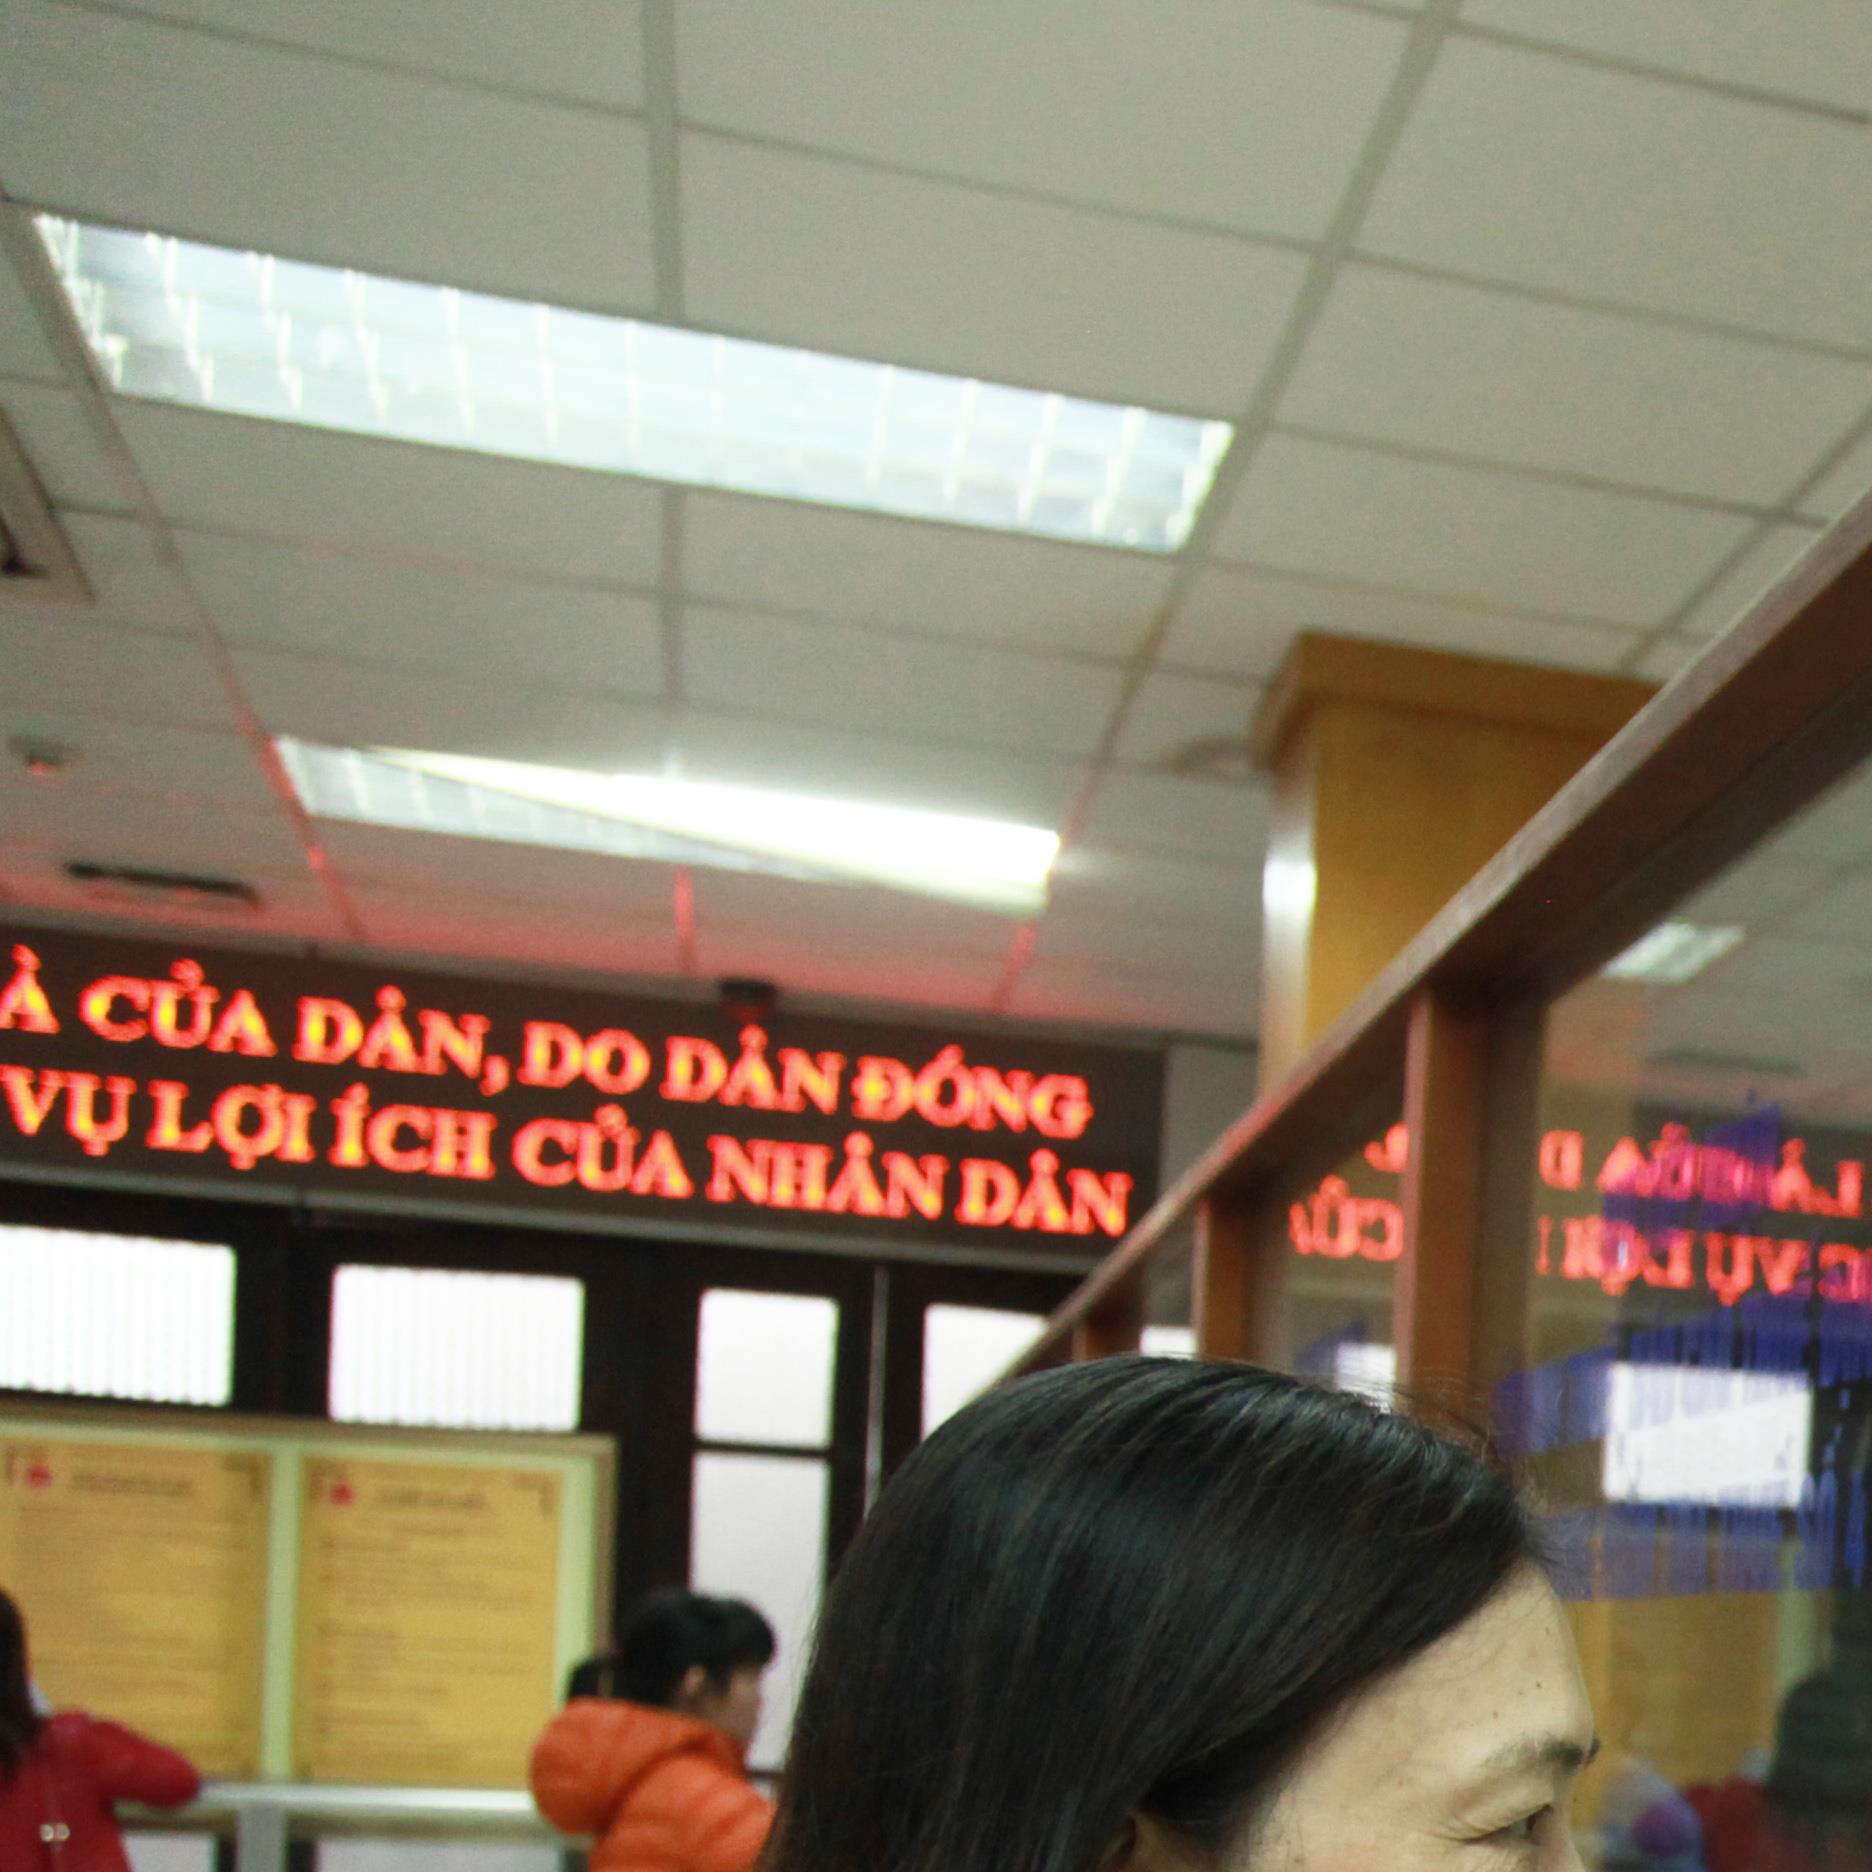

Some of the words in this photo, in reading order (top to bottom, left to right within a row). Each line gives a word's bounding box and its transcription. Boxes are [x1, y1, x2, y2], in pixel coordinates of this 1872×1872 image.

[78, 958, 277, 1057] CỦA
[516, 1020, 652, 1095] DO
[0, 1064, 137, 1156] VỤ
[145, 1080, 317, 1170] LỢI
[328, 1082, 498, 1180] ÍCH
[511, 1103, 695, 1199] CỦA
